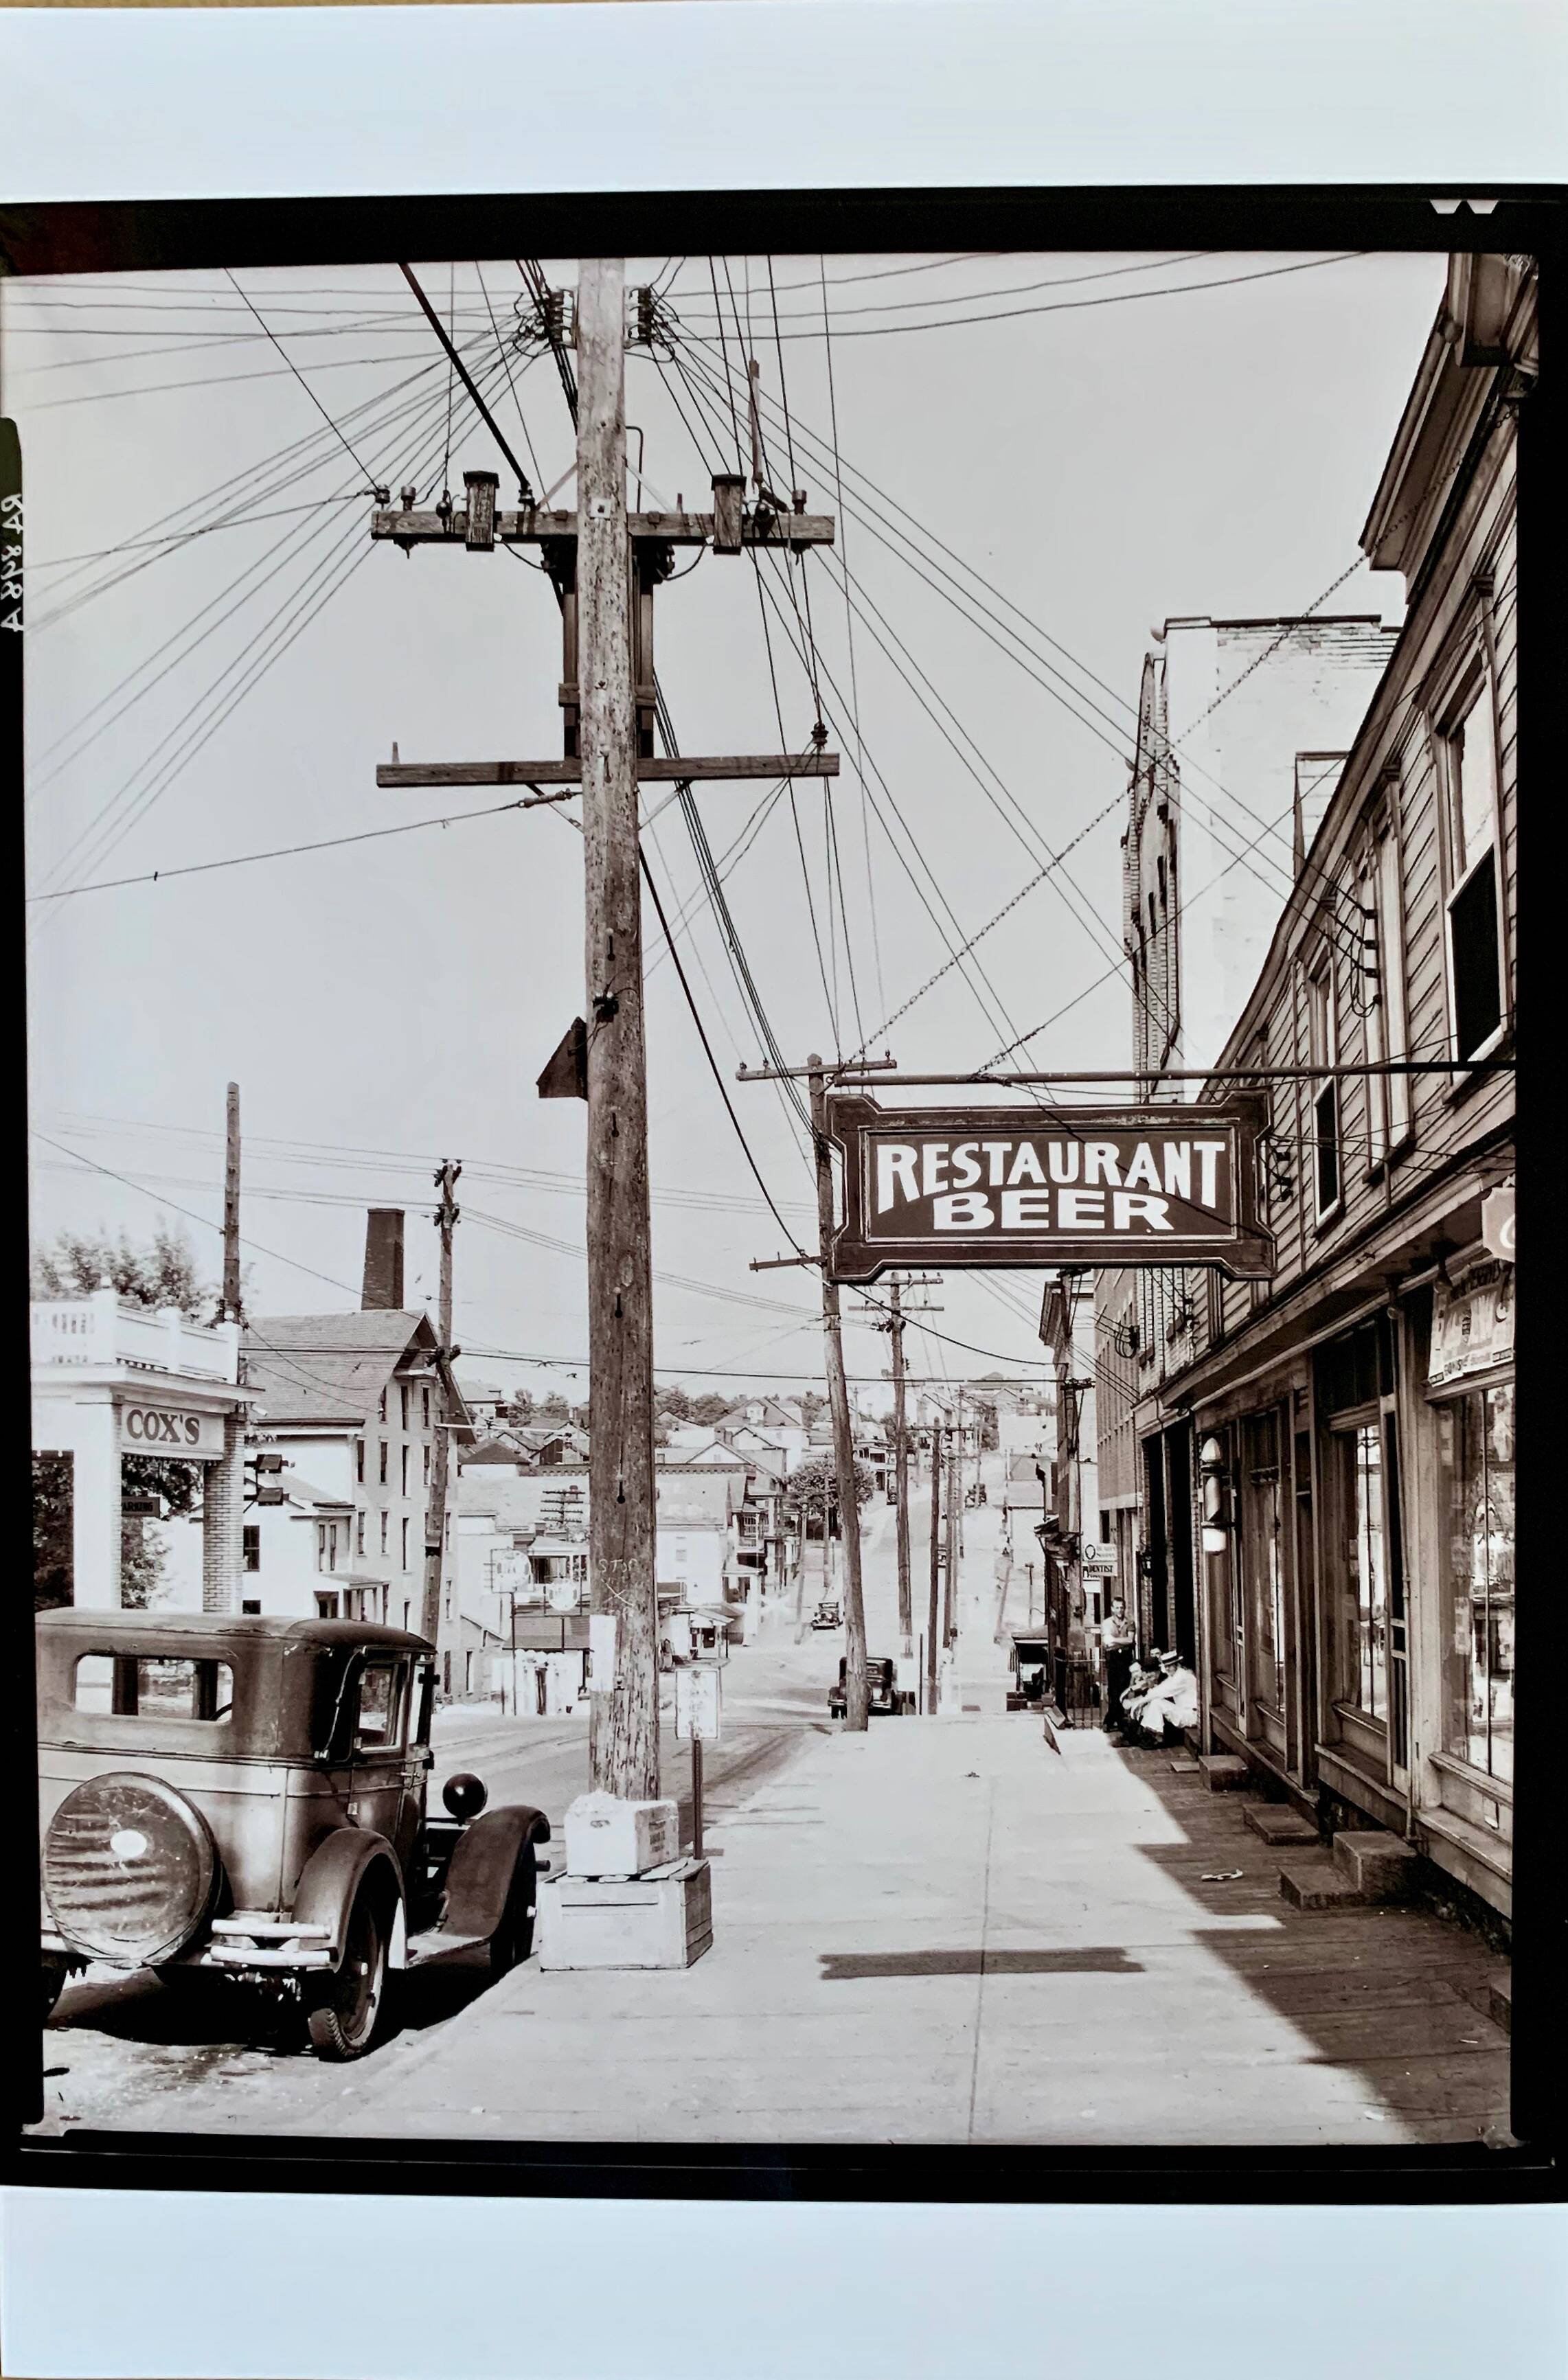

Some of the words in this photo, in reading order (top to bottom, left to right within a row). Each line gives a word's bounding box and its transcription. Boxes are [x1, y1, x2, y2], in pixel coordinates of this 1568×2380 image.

[877, 1141, 1225, 1214] RESTAURANT
[933, 1189, 1174, 1231] BEER
[127, 1410, 200, 1445] COX'S
[122, 1502, 153, 1512] ARKING
[599, 1558, 638, 1572] STOP
